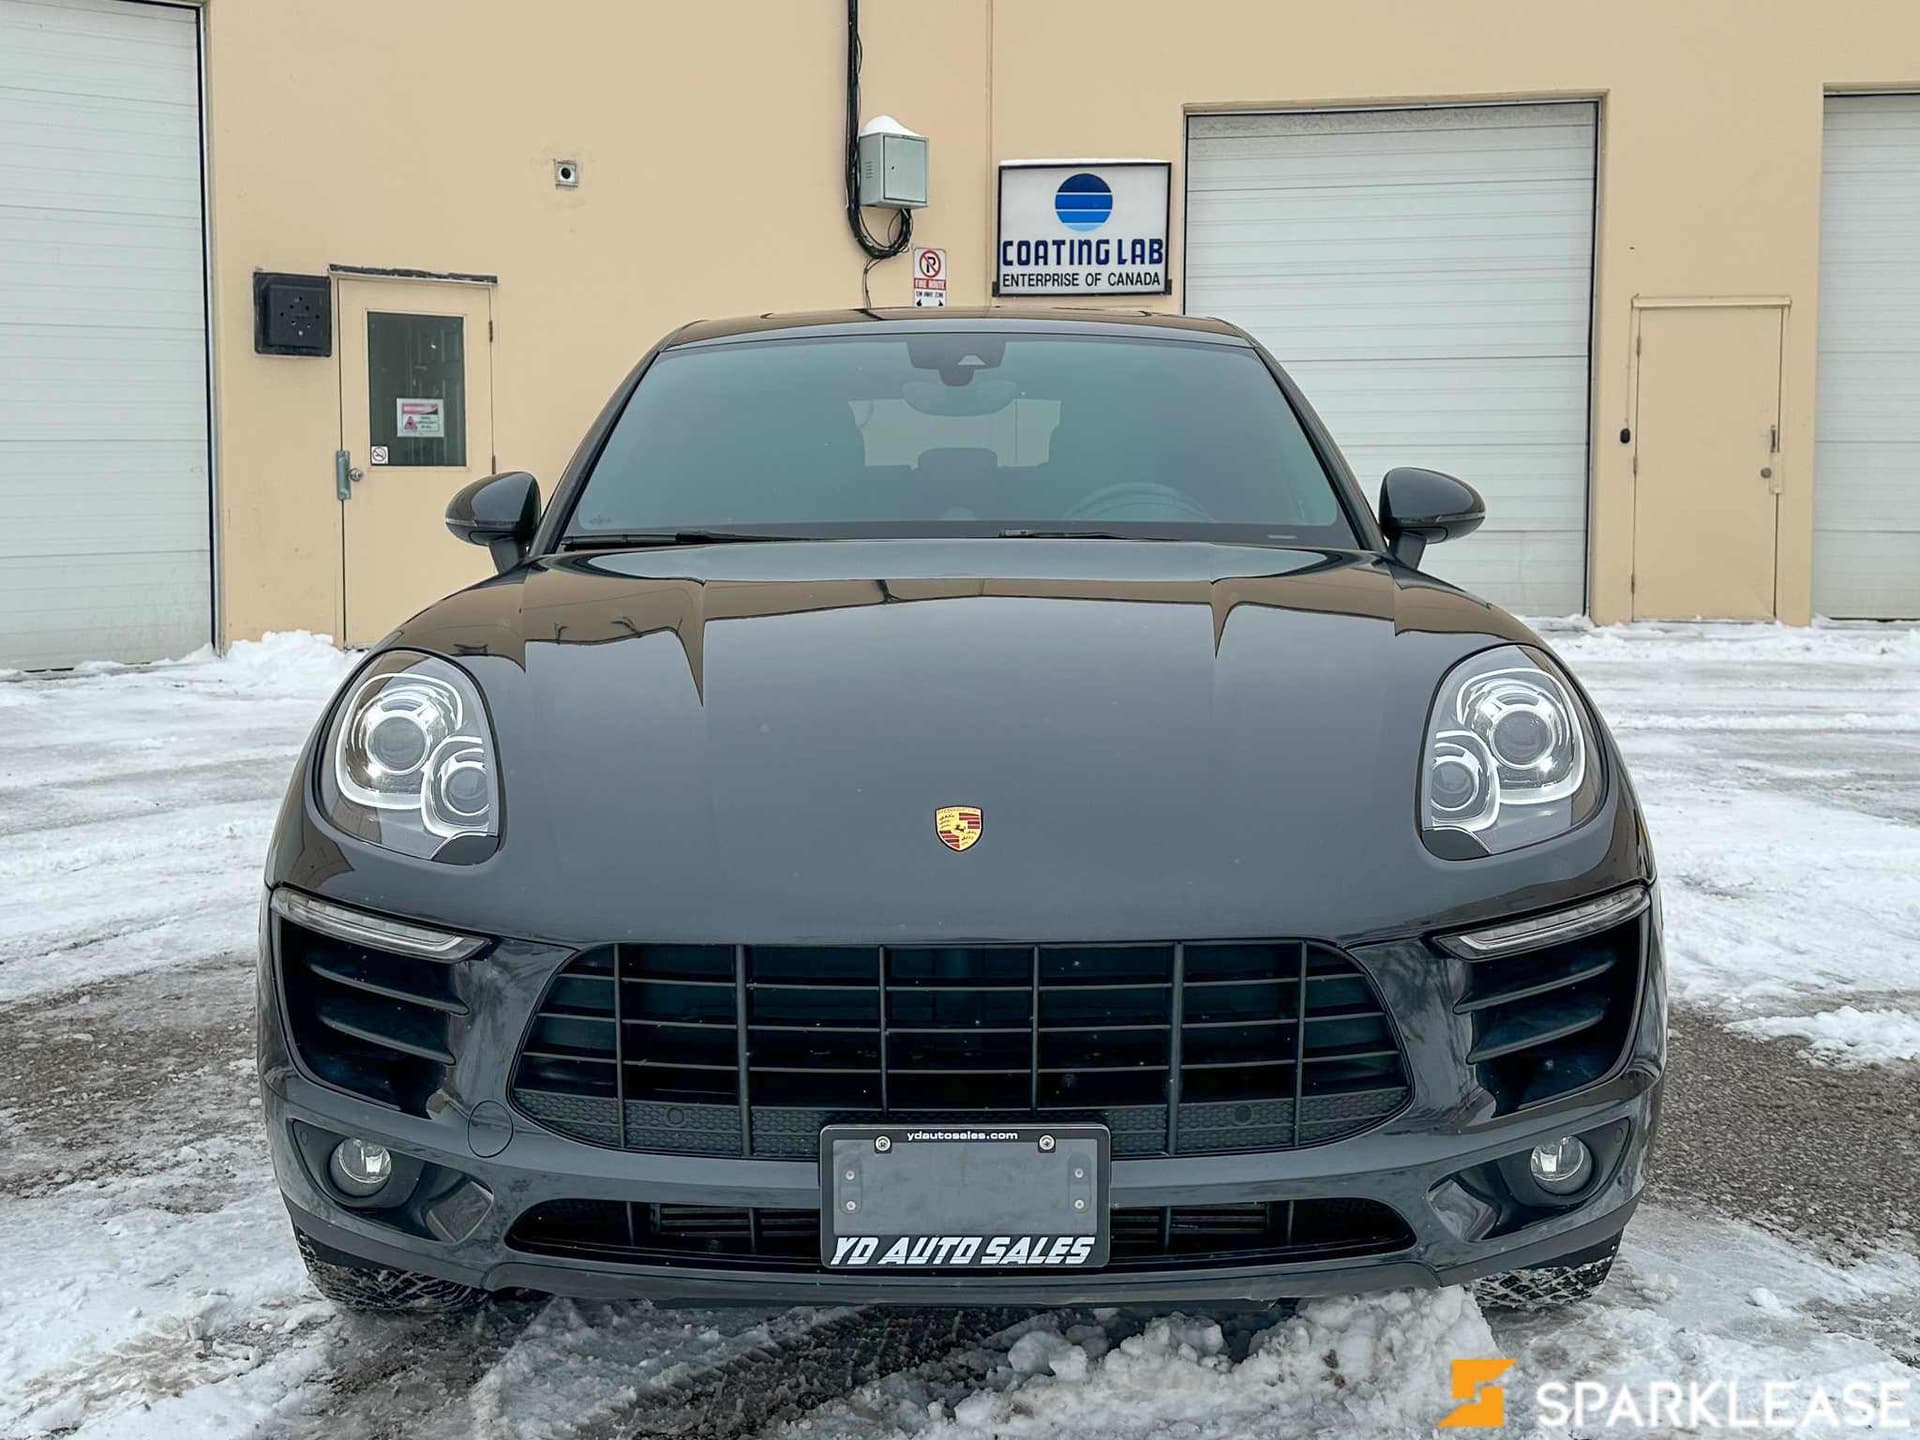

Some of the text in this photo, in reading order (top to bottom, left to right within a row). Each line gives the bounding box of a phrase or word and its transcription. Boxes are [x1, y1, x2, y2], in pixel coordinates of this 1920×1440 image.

[1002, 238, 1164, 266] COATING LAB
[1002, 271, 1161, 288] ENTERPRISE OF CANADA
[906, 1130, 1018, 1141] ydautosales.com
[830, 1236, 1096, 1265] YD AUTO SALES
